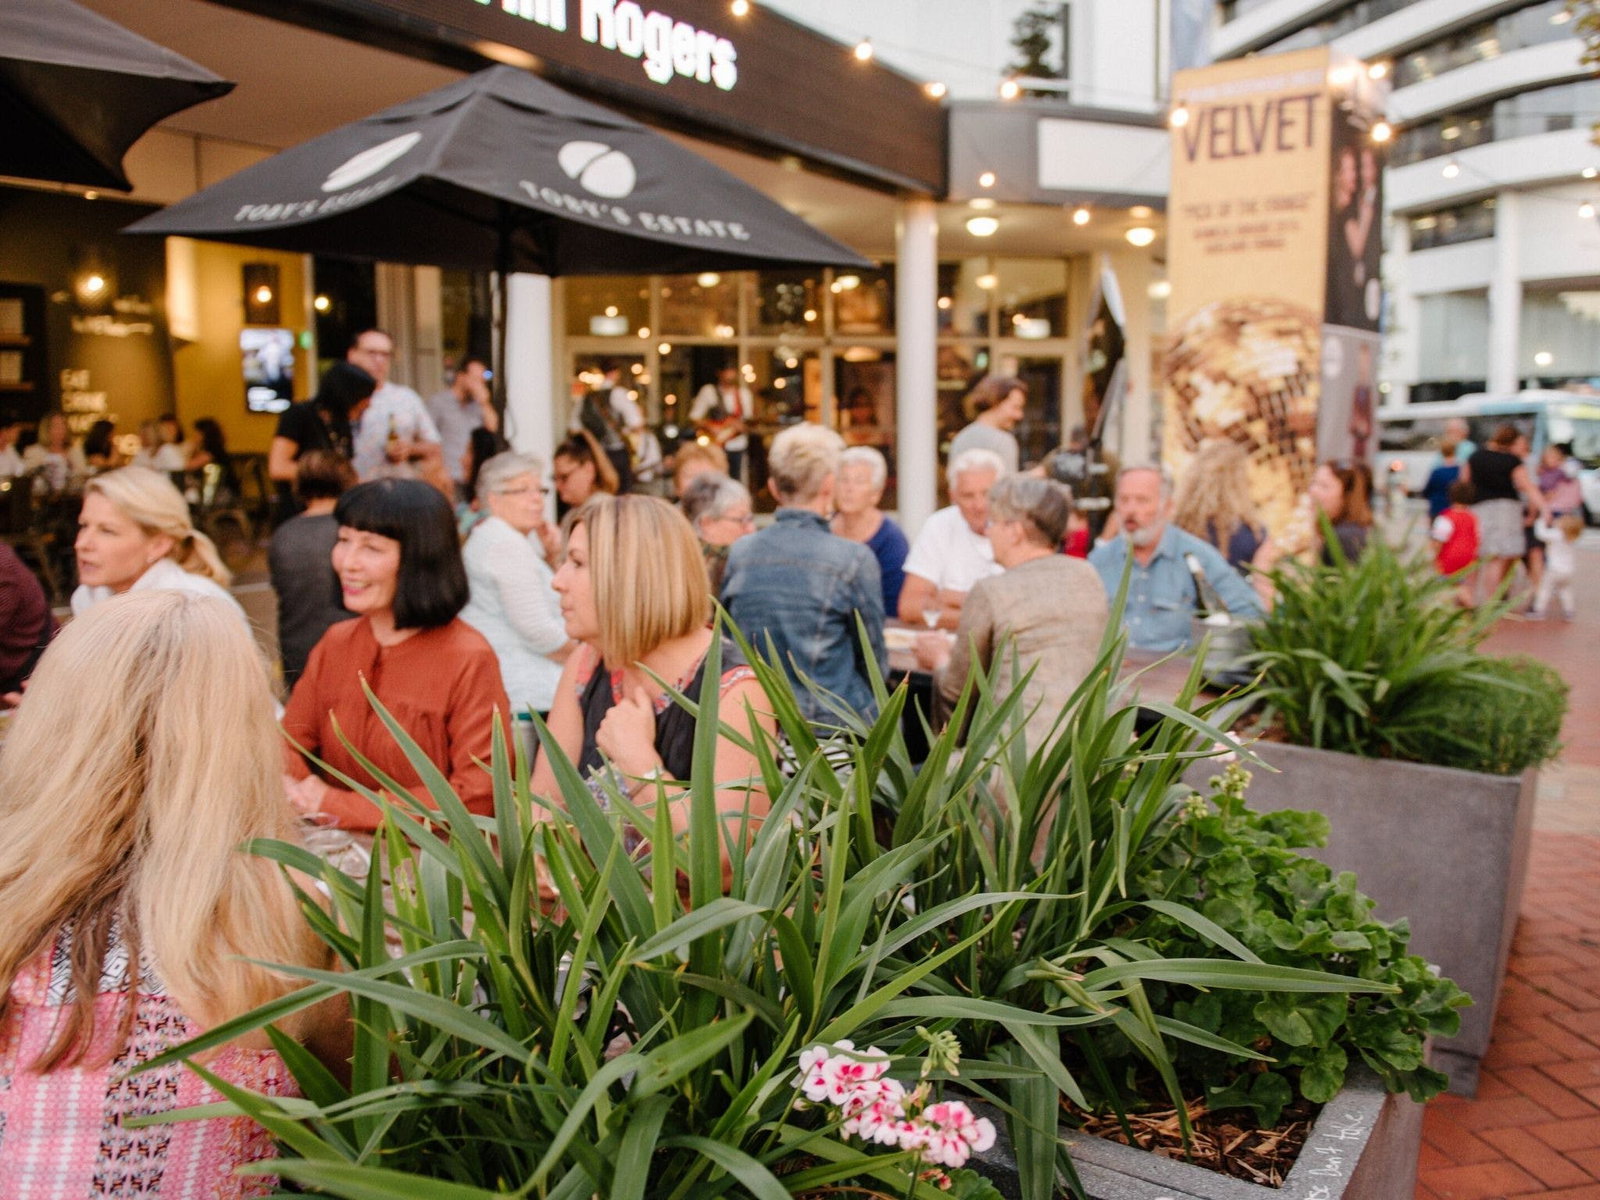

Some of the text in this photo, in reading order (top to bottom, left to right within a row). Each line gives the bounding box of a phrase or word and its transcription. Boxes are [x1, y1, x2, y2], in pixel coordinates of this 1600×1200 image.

[1181, 93, 1322, 162] VELVET
[234, 199, 319, 222] TOBY'S
[519, 180, 750, 241] TOBY'S ESTATE
